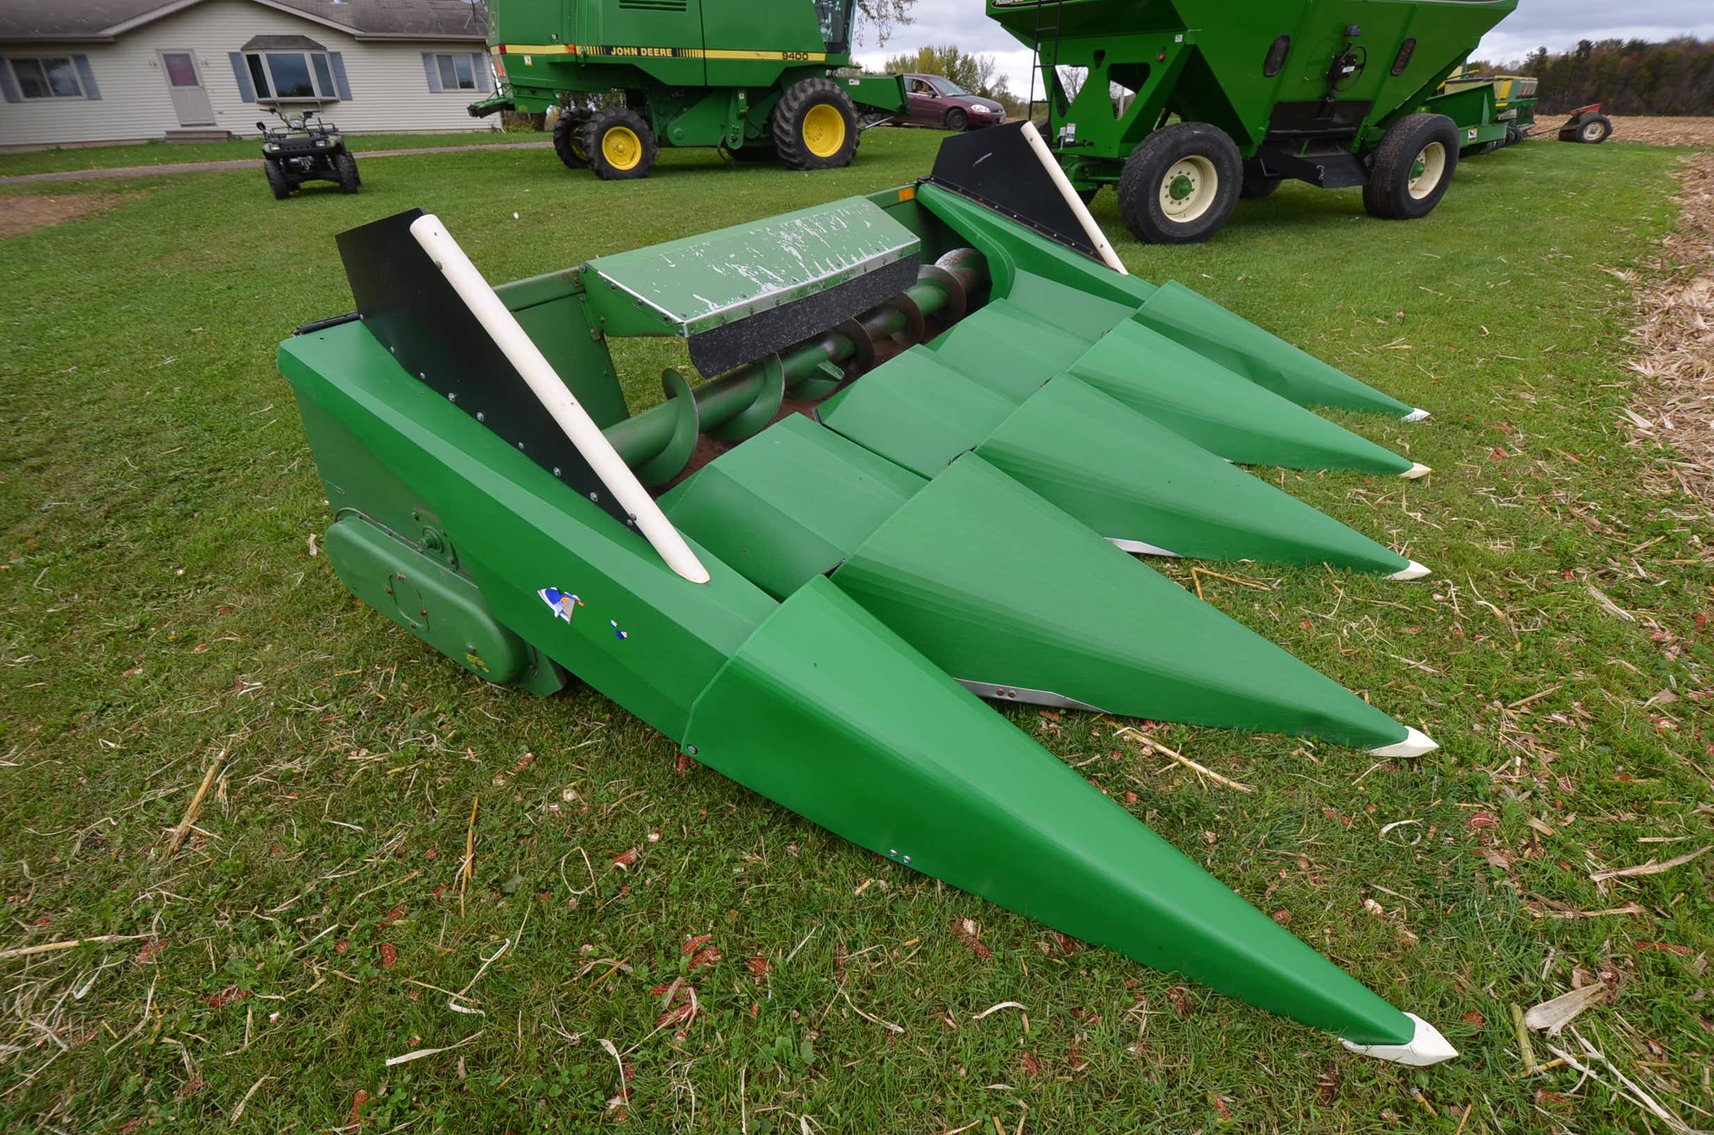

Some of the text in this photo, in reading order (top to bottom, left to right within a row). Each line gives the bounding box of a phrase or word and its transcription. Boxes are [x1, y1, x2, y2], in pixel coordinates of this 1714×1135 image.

[610, 47, 673, 57] JOHN DEERE
[782, 52, 809, 61] 9400
